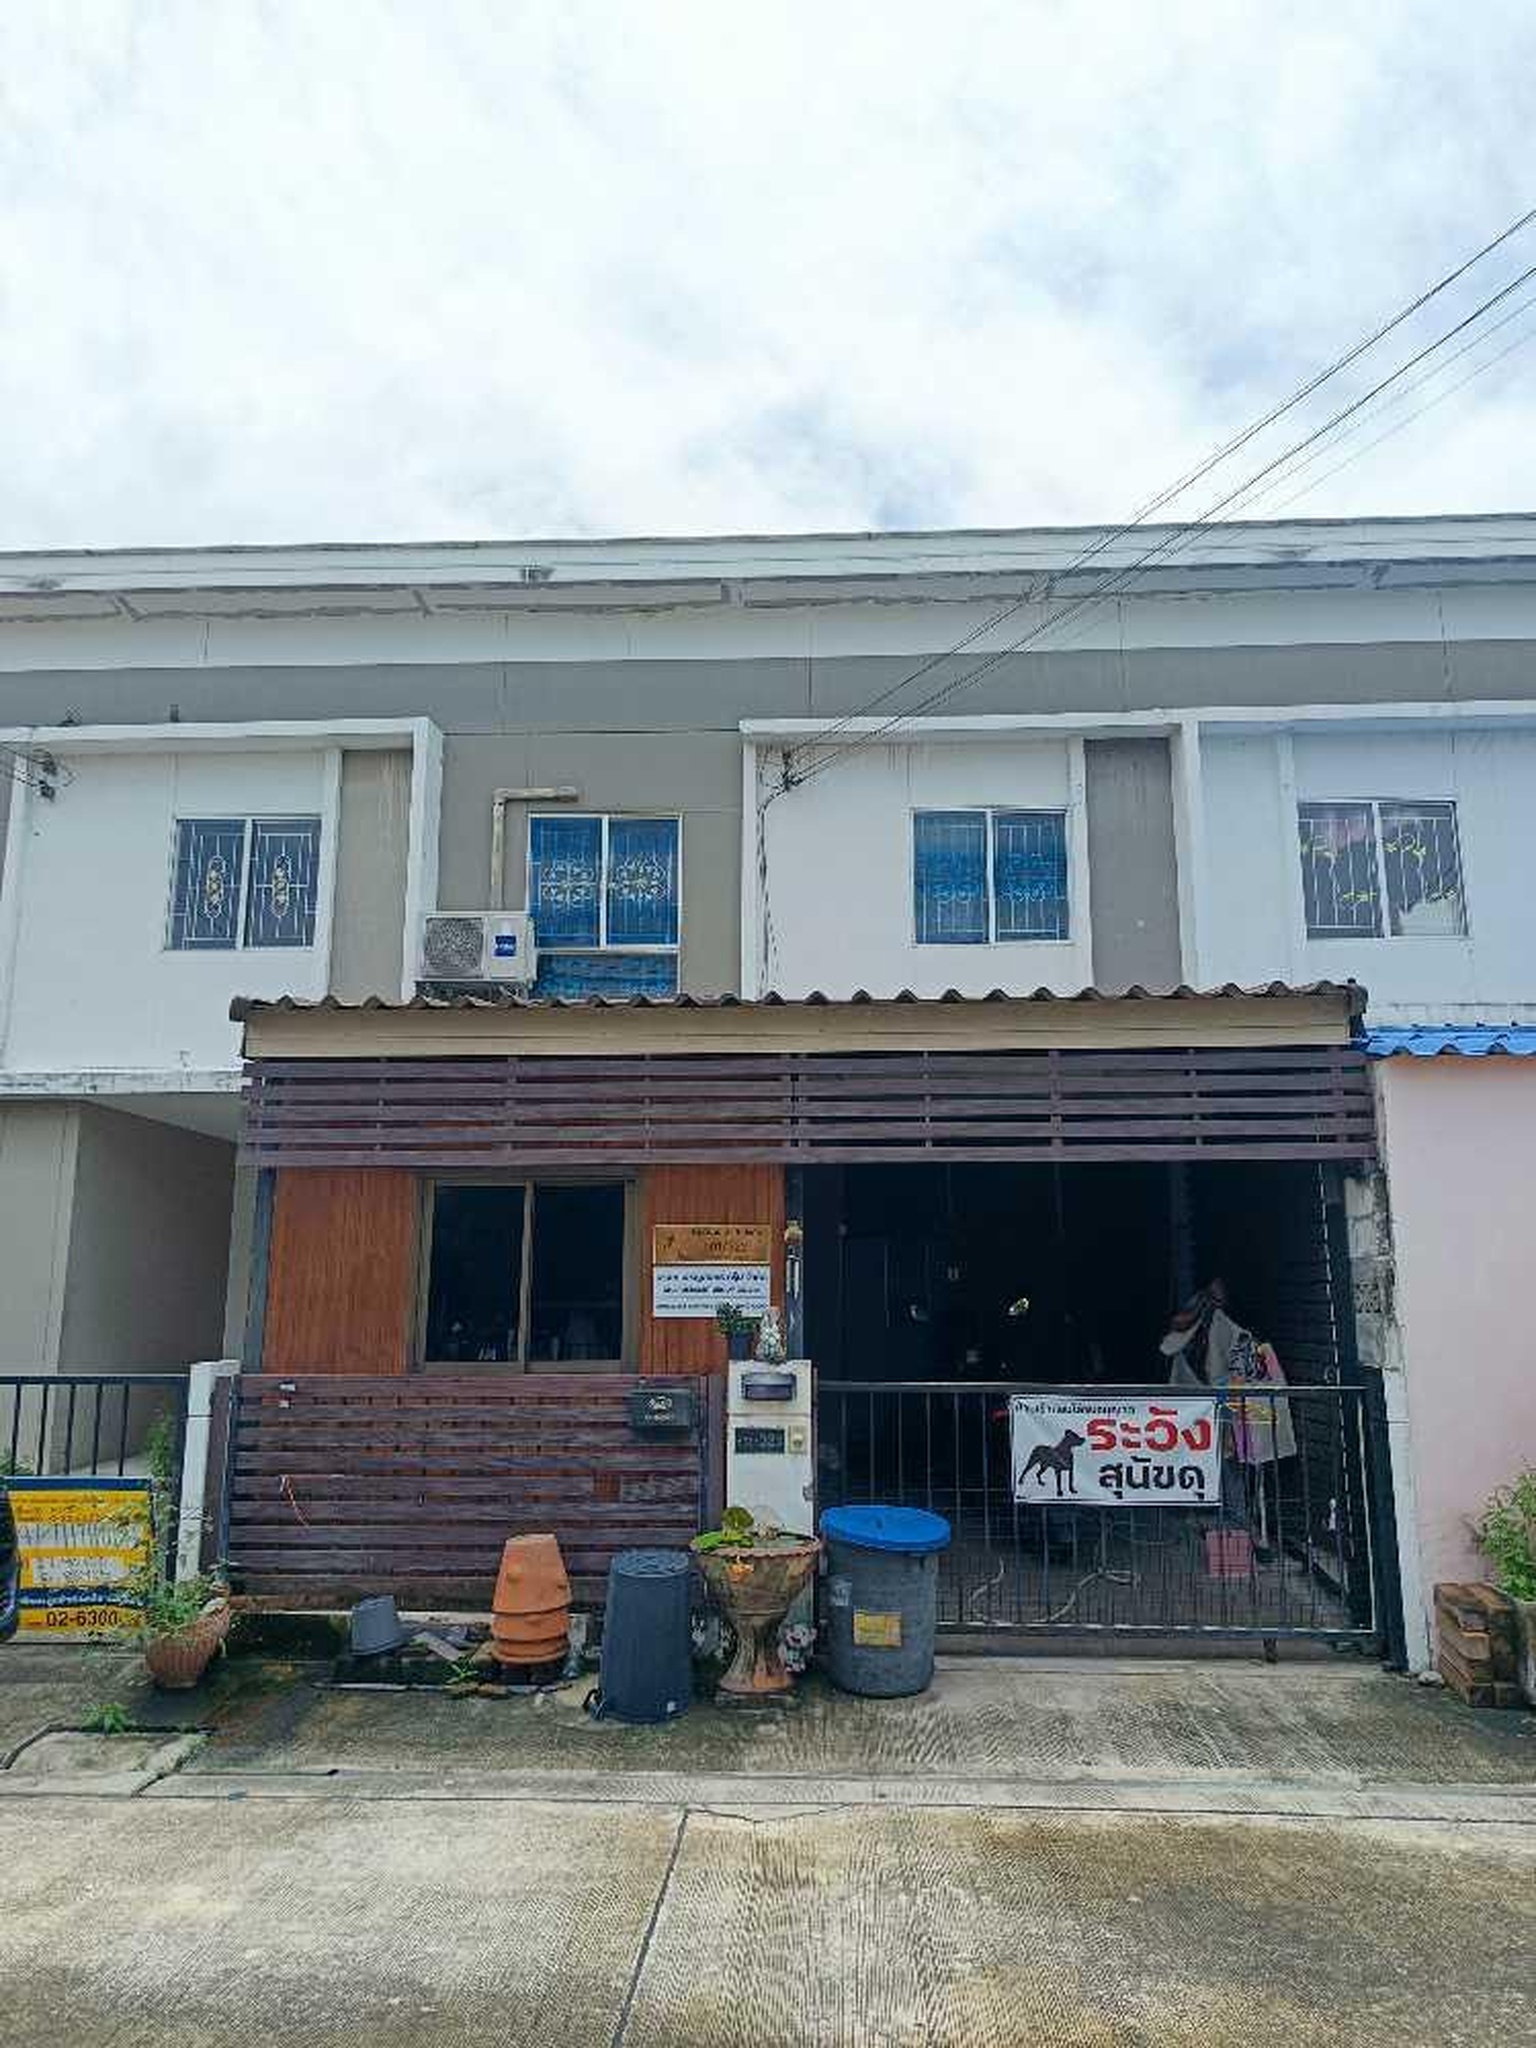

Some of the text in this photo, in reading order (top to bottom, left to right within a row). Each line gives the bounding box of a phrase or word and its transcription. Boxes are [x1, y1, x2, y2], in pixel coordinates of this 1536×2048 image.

[1086, 1406, 1212, 1452] ระวัง
[1098, 1455, 1206, 1501] สุนัขดุ
